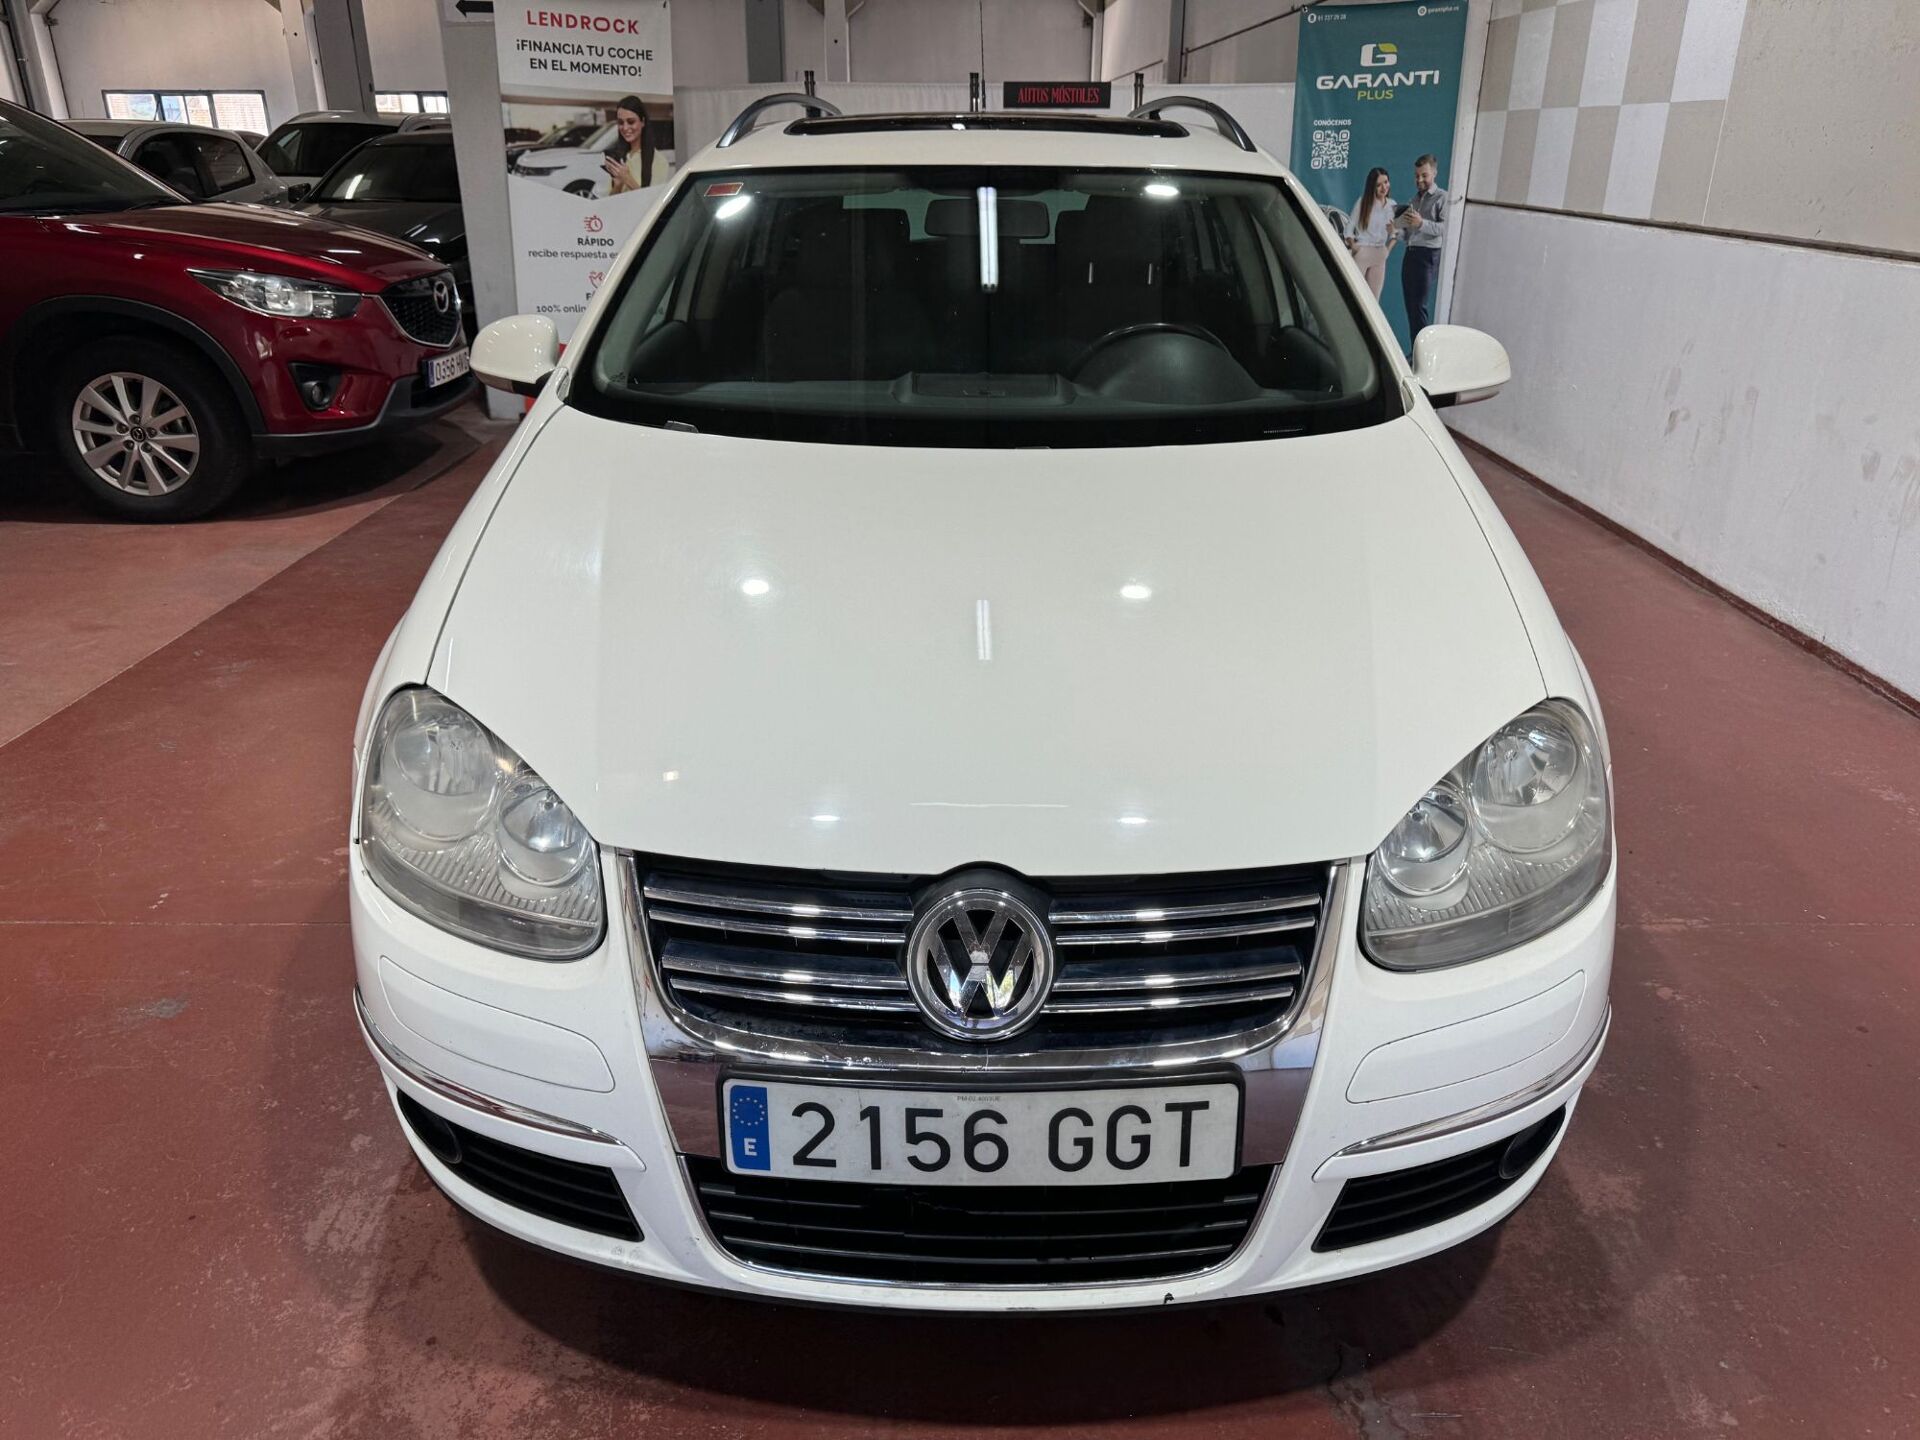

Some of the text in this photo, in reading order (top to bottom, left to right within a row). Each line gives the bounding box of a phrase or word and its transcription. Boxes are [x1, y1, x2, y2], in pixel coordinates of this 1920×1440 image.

[526, 10, 640, 35] LENDROCK
[516, 39, 653, 61] ¡FINANCIA TU COCHE
[529, 58, 642, 77] EN EL MOMENTO!
[1316, 70, 1440, 90] GARANTI
[1018, 85, 1100, 104] AUTOS MÓSTOLES
[1357, 89, 1394, 101] PLUS
[1313, 118, 1352, 126] CONÓCENOS
[577, 236, 614, 247] RÁPIDO
[528, 249, 558, 258] recibe
[560, 251, 608, 260] respuesta
[536, 304, 587, 313] 100% onlin
[743, 1100, 1210, 1173] E 2156 GGT
